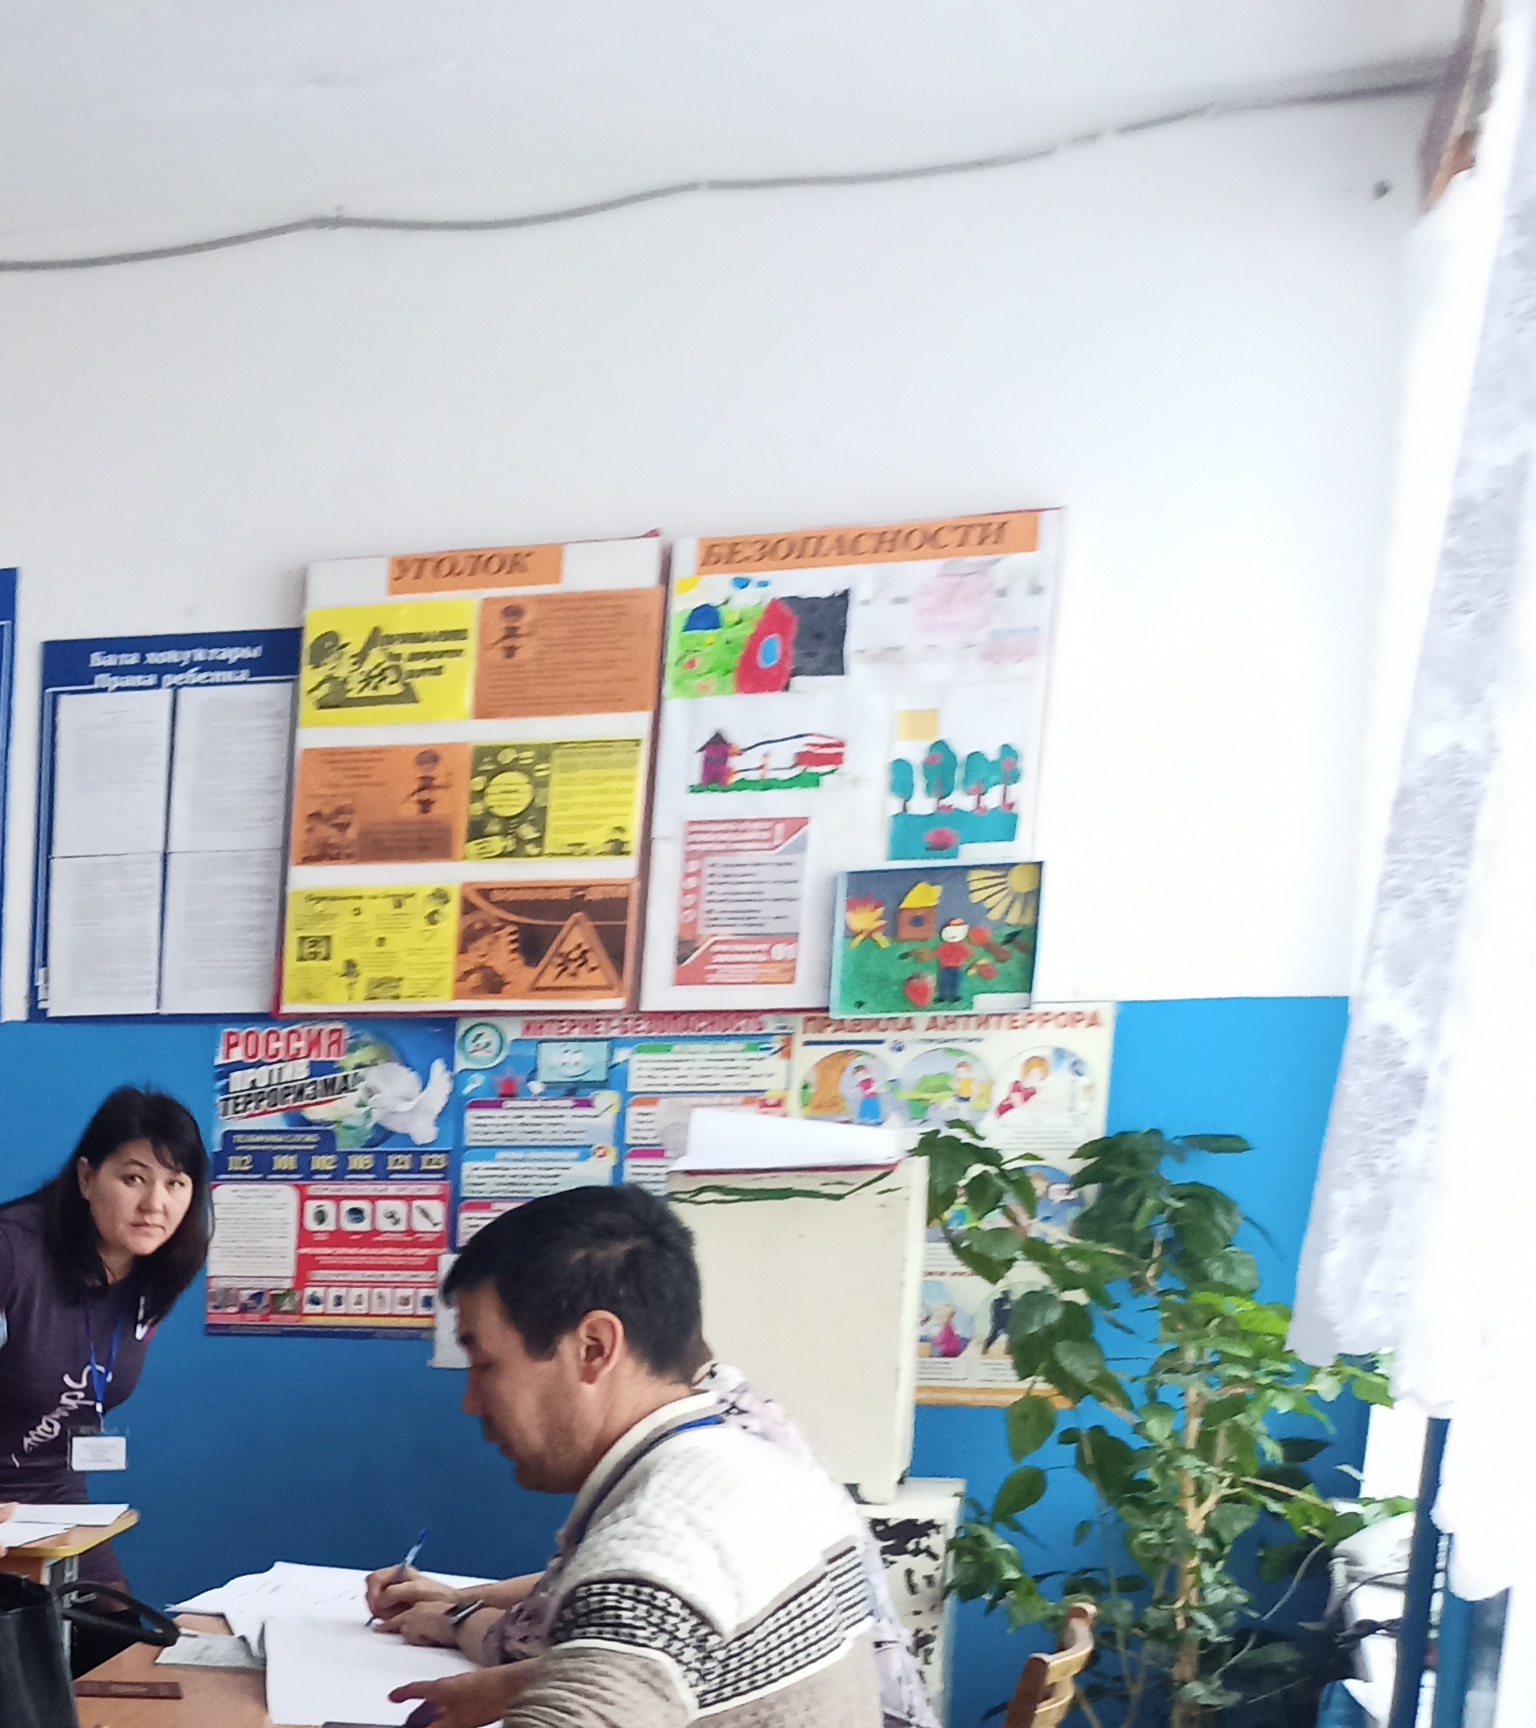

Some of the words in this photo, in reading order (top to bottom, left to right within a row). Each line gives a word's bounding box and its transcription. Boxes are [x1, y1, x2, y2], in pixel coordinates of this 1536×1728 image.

[700, 521, 1009, 567] БЕЗОПАСНОСТИ
[392, 552, 534, 580] УГОЛОК
[93, 673, 158, 693] Права
[801, 1016, 917, 1034] ПРАВИЛА
[924, 1011, 1105, 1032] АНТИТЕРРОРА
[222, 1027, 345, 1061] РОССИЯ
[229, 1060, 310, 1092] ПРОТИВ
